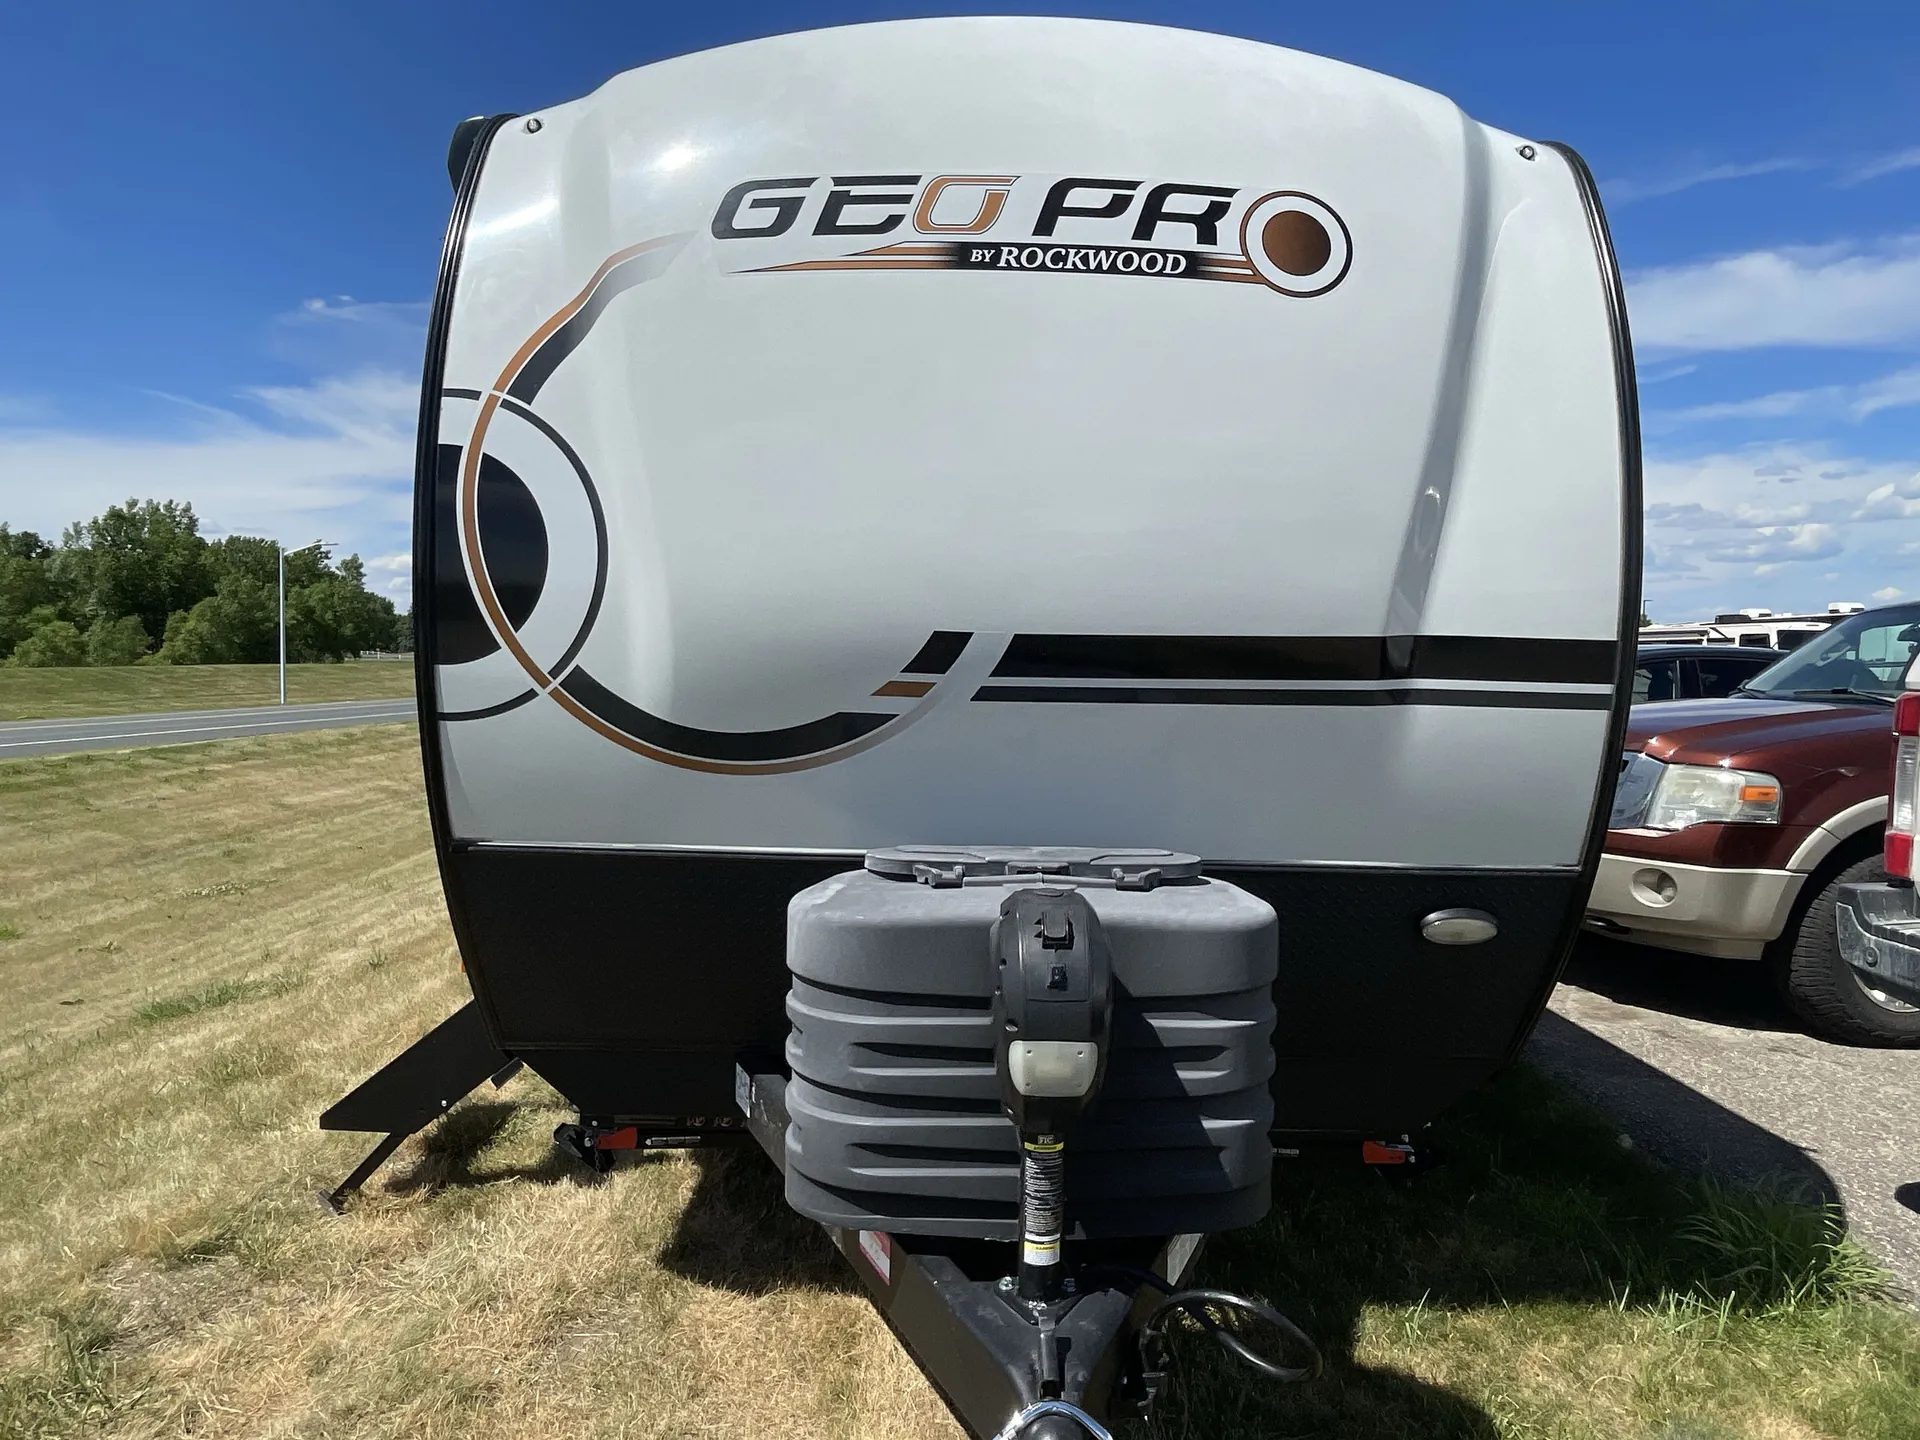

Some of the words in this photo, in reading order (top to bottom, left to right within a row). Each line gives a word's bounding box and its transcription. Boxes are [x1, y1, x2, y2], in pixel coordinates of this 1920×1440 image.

[711, 174, 1022, 241] GEO
[969, 248, 996, 264] BY
[996, 246, 1188, 275] ROCKWOOD
